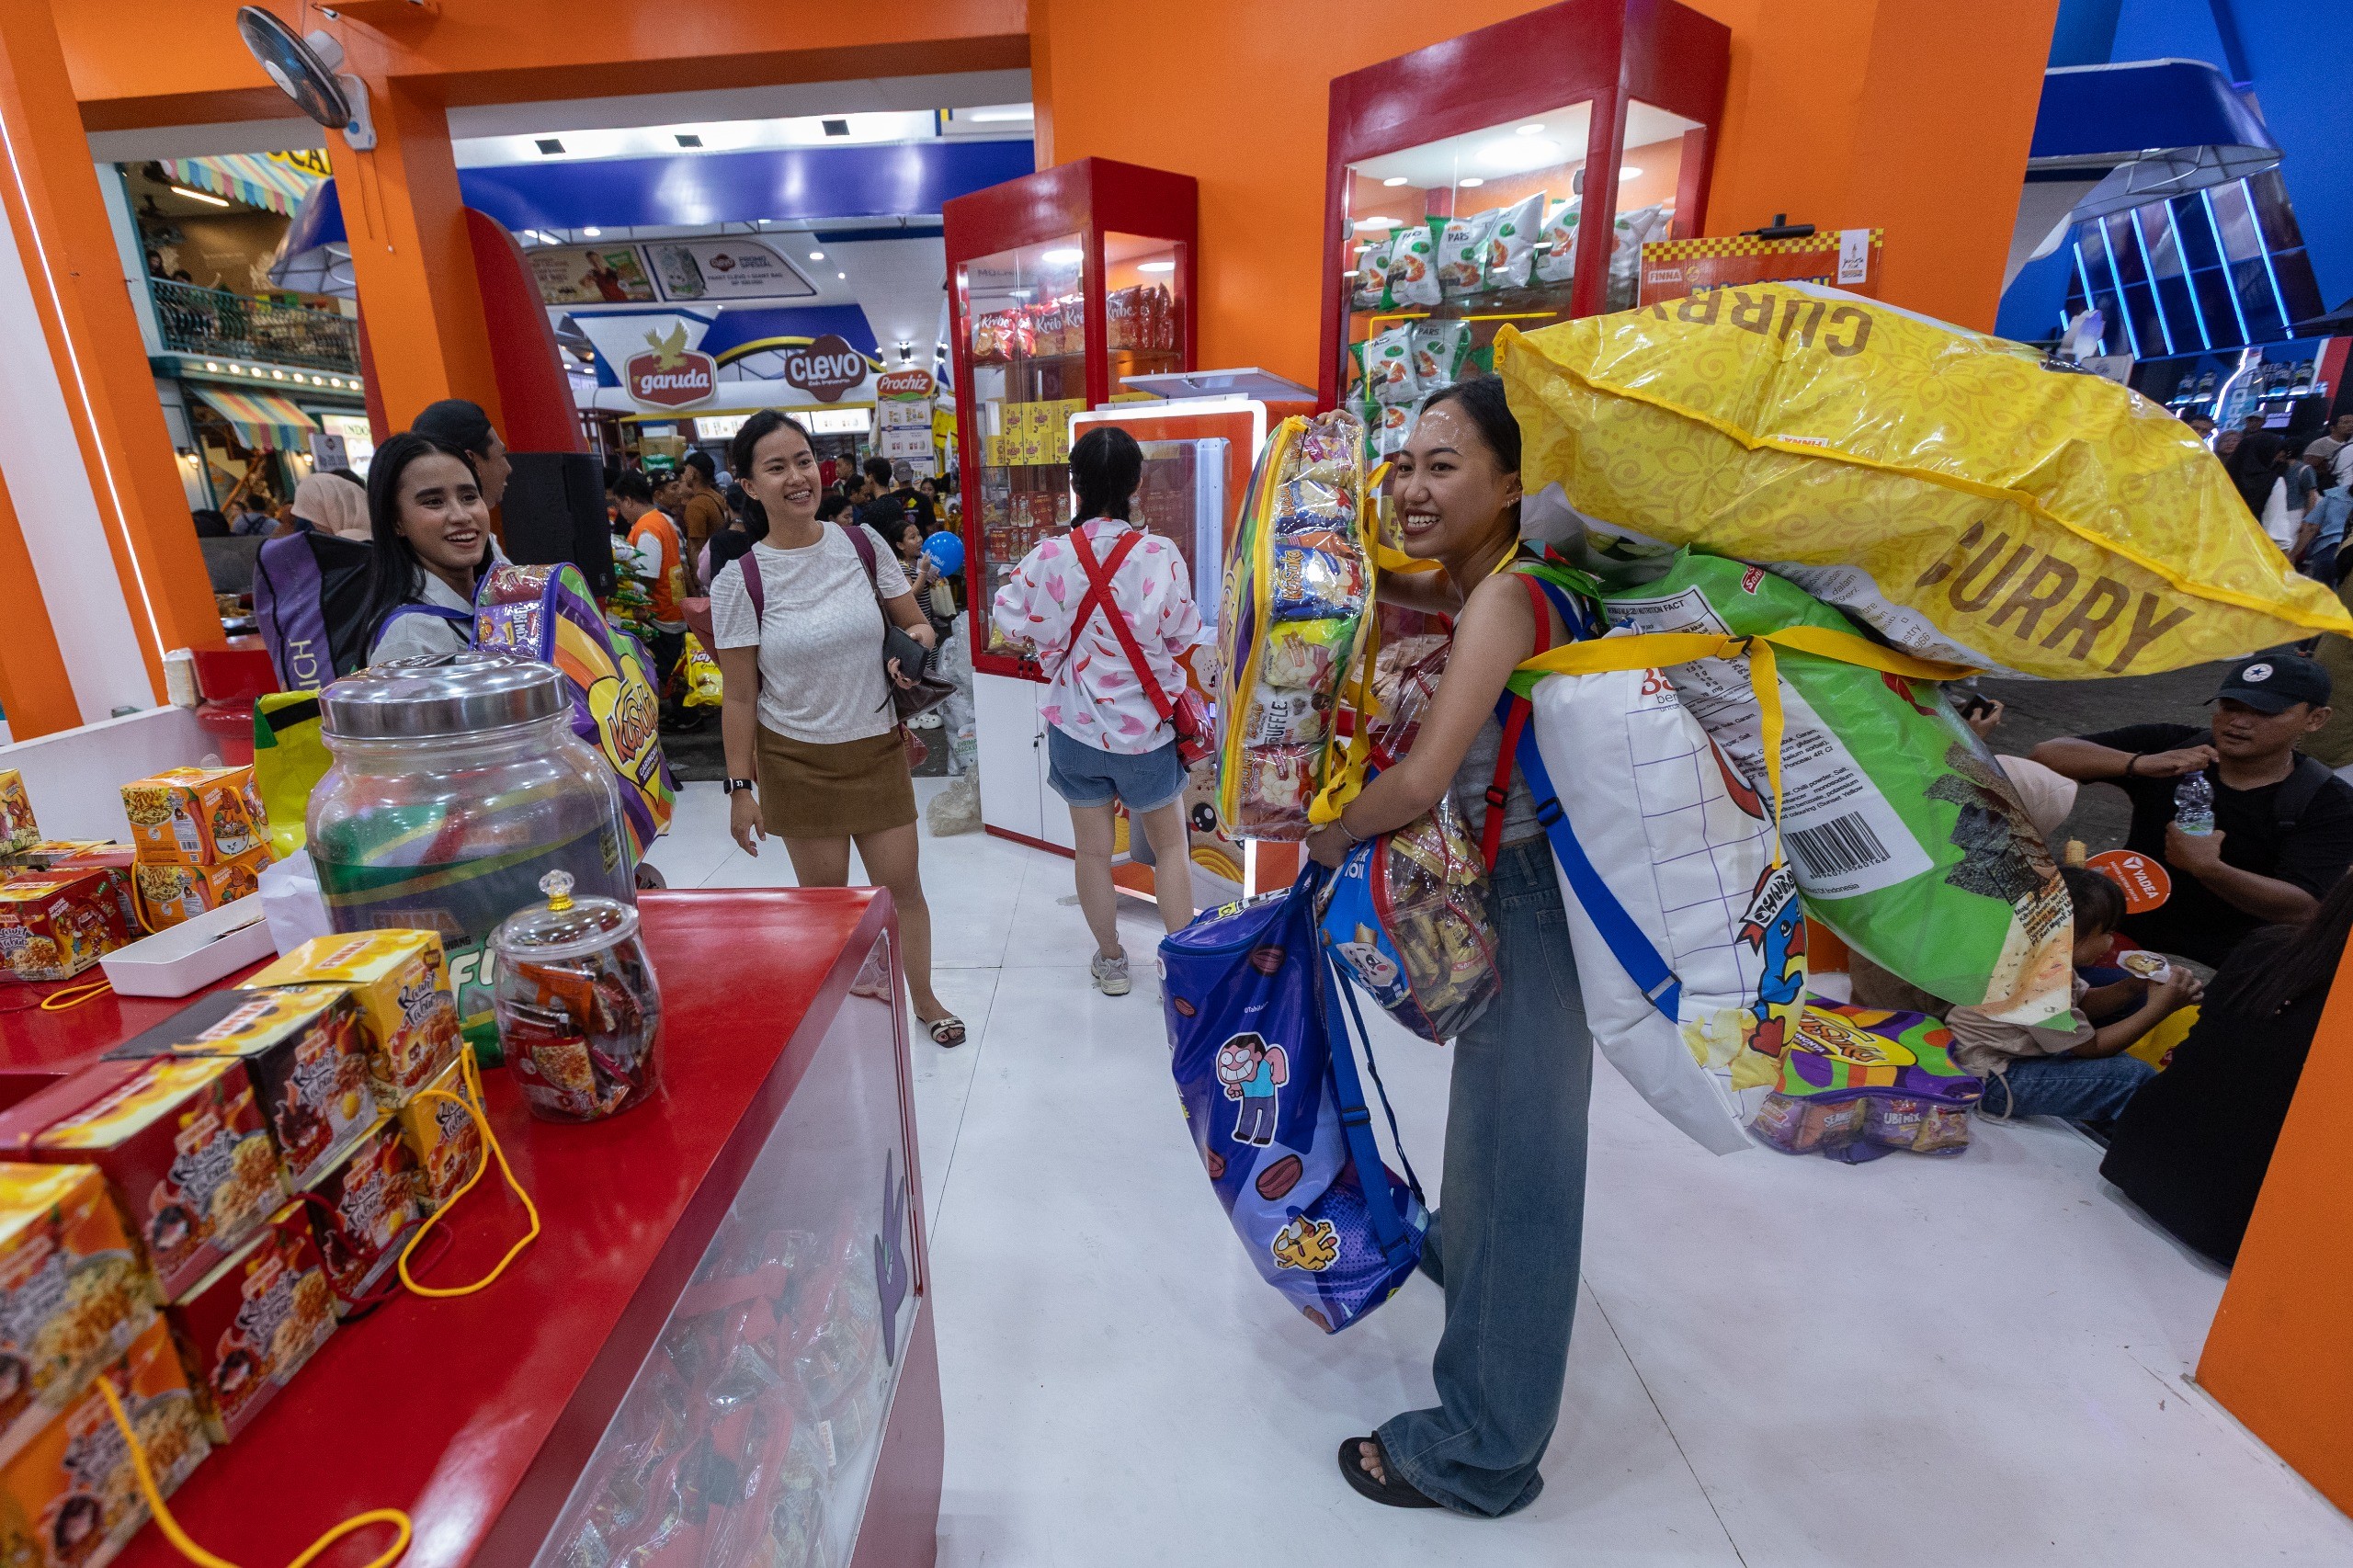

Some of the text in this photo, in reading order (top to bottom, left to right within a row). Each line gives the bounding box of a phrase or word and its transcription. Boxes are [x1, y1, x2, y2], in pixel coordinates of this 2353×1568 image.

[1448, 232, 1470, 242] PARS
[1649, 270, 1681, 281] FINNA
[1418, 327, 1439, 335] PARS
[640, 368, 710, 394] garuda
[879, 374, 929, 391] Prochiz
[1832, 574, 1858, 596] dalam
[1915, 519, 2195, 674] CURRY
[1664, 600, 1685, 612] FACT
[1900, 623, 1923, 643] ustry
[290, 639, 321, 690] ICH
[1711, 685, 1724, 694] mg
[1780, 737, 1794, 746] ubuk,
[1796, 734, 1824, 748] glutamat,
[1782, 750, 1804, 761] kalium
[1784, 756, 1813, 769] Ponceau
[1813, 772, 1855, 793] monosodium
[1789, 805, 1816, 818] colouring
[1817, 796, 1842, 809] (Sunset
[1842, 785, 1864, 798] Yellow
[1796, 795, 1825, 809] benzoate,
[1825, 778, 1859, 797] potassium
[1853, 857, 1888, 871] 560168
[1826, 883, 1860, 894] Indonesia
[2132, 869, 2160, 899] YADEA
[0, 925, 28, 937] awit
[398, 971, 437, 1009] Rawit
[405, 994, 437, 1026] Tabur
[291, 1046, 338, 1087] Rawit
